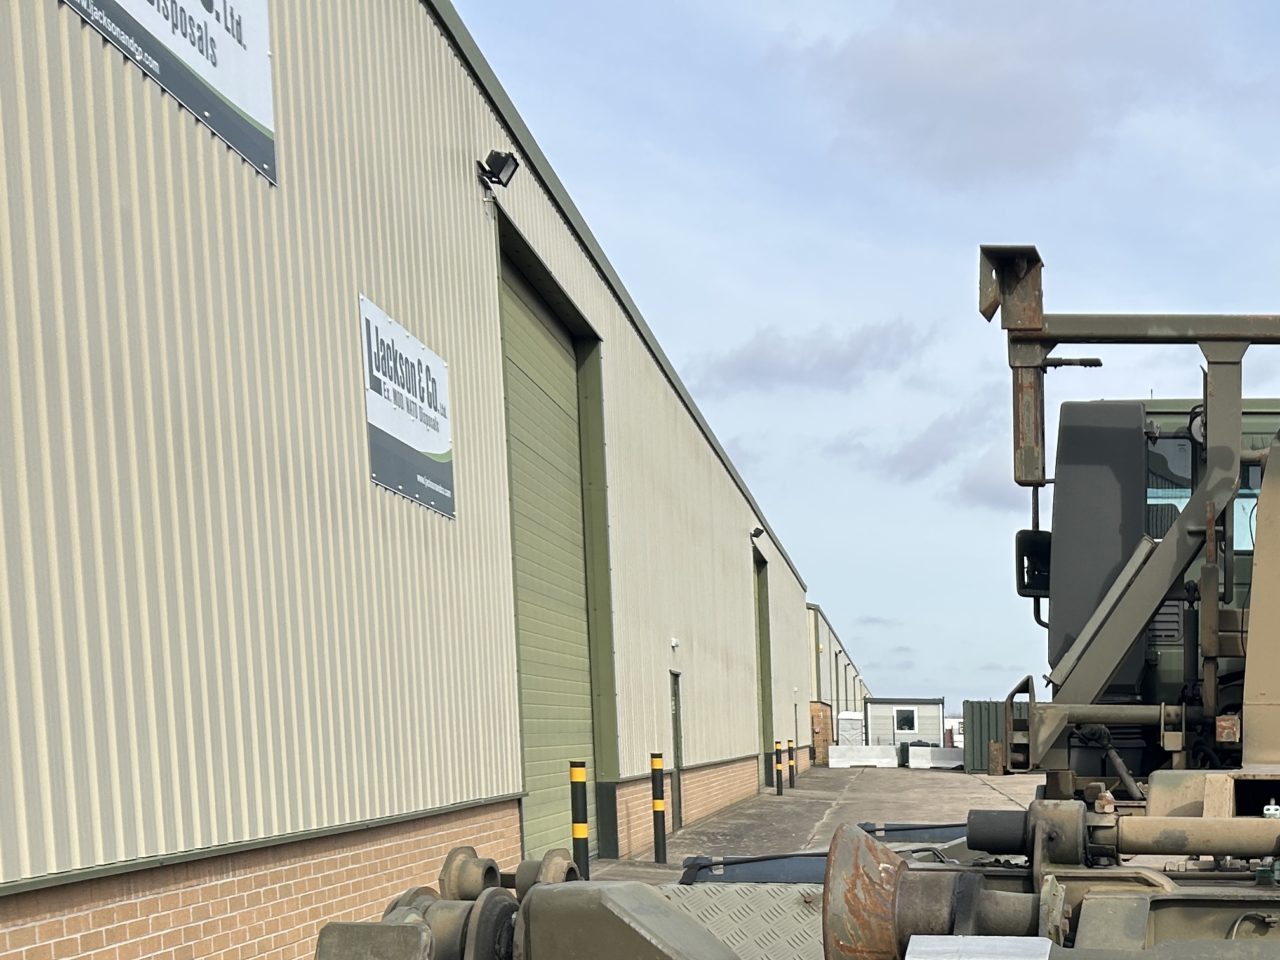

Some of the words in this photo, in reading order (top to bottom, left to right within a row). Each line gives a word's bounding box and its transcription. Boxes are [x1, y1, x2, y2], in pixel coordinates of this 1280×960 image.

[76, 0, 160, 74] w.ljacksonandco.com
[150, 0, 217, 68] sposals
[222, 0, 247, 51] Ltd.
[417, 358, 425, 403] &
[425, 364, 440, 414] Co.
